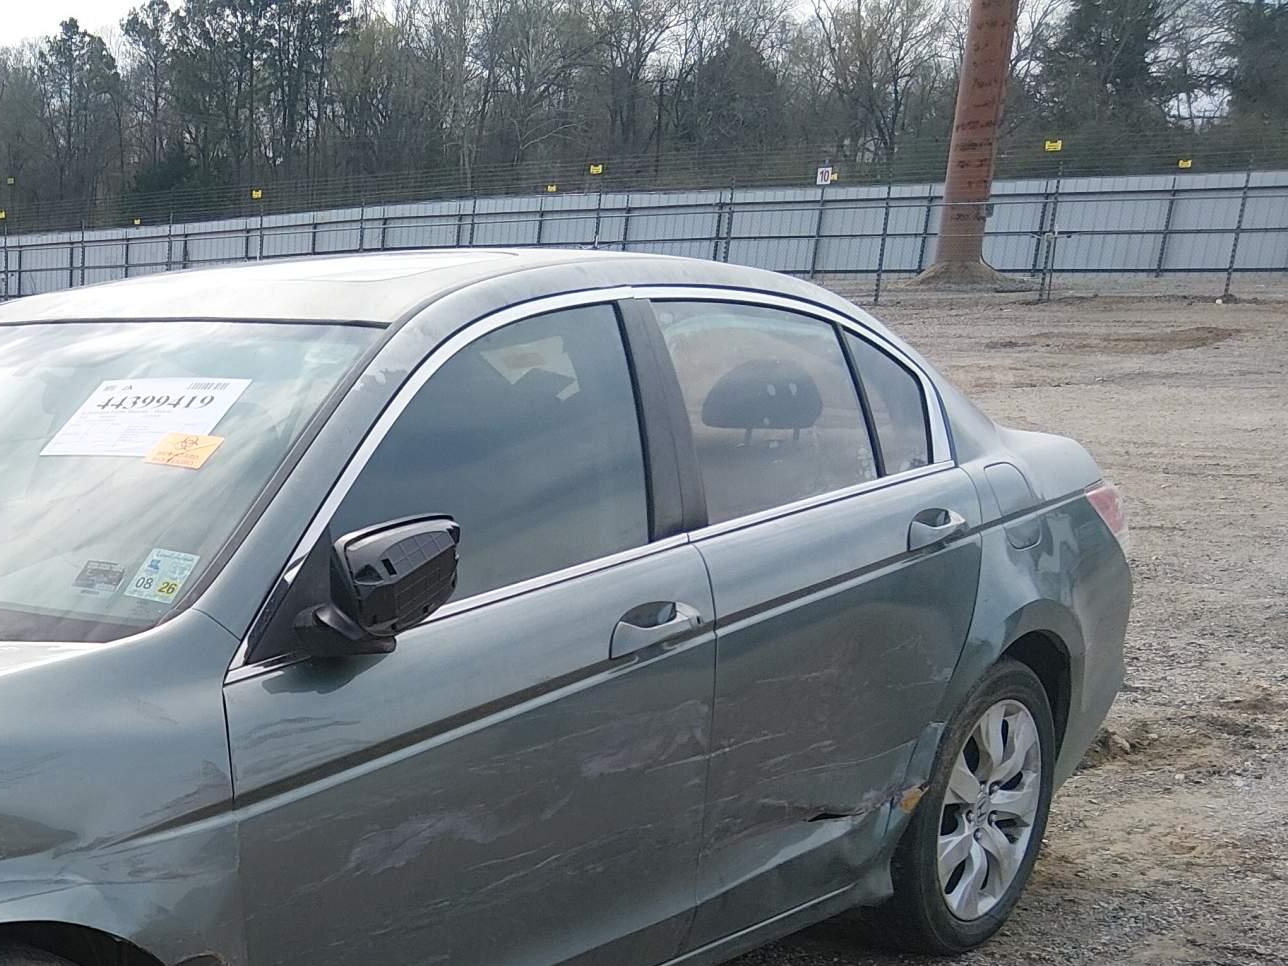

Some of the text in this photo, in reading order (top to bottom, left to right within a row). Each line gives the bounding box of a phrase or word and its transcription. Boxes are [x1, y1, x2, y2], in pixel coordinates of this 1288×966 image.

[819, 170, 829, 182] 10
[97, 395, 215, 410] 44399419
[135, 576, 154, 589] 08
[158, 581, 178, 594] 26
